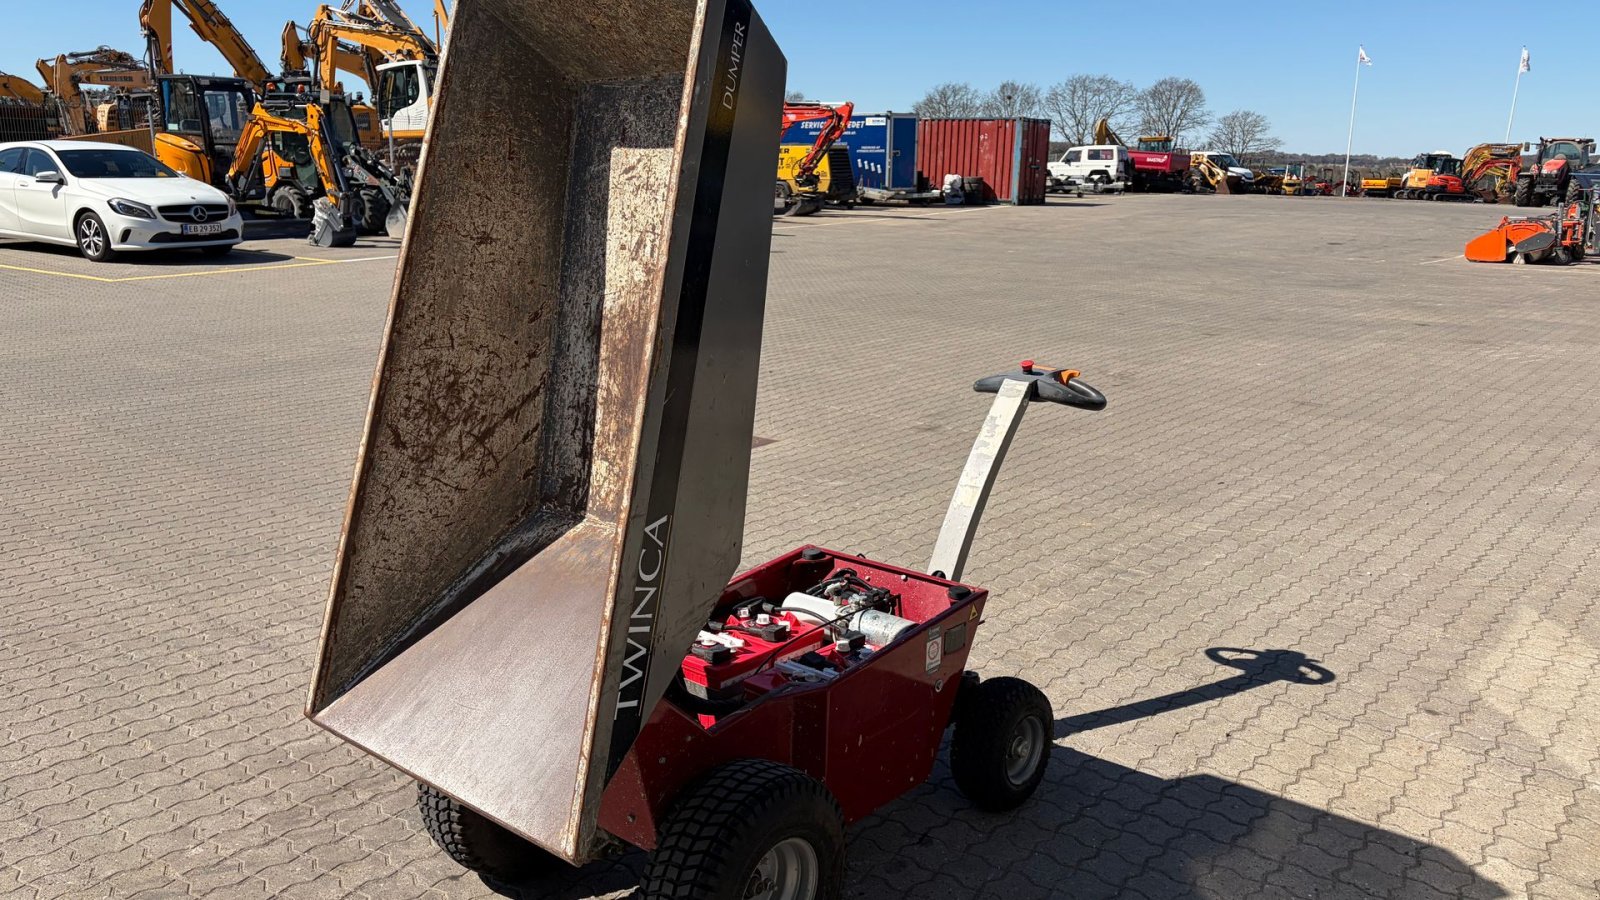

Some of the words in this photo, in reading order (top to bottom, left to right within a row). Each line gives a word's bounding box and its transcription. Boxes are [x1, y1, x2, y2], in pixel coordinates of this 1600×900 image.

[722, 21, 746, 110] DUMPER
[188, 225, 198, 233] EB
[613, 514, 669, 720] TWINCA
